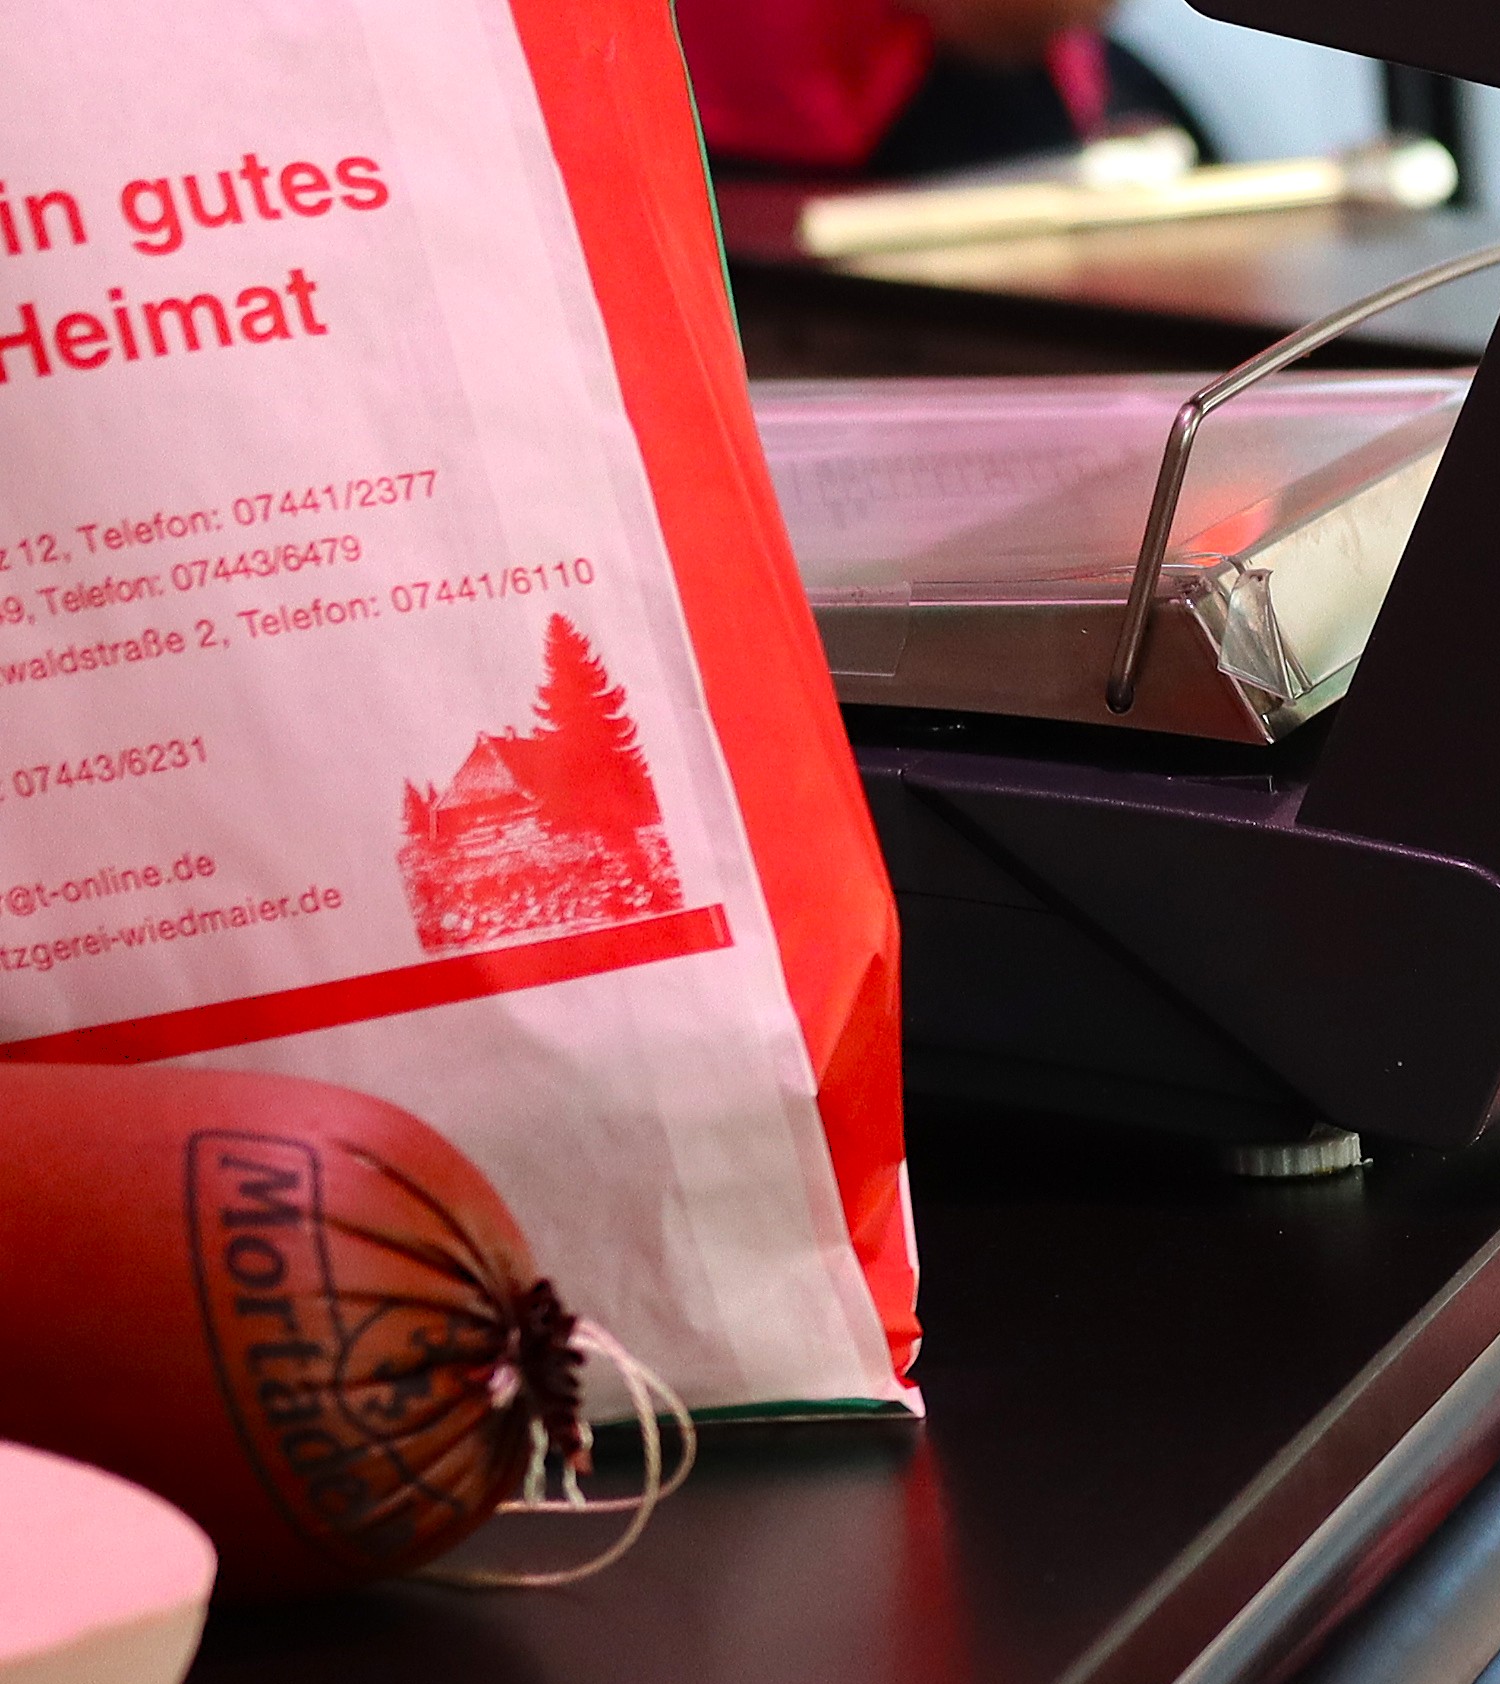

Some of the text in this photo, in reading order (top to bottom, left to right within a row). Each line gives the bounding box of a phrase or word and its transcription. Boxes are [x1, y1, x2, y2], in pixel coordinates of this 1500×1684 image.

[120, 153, 389, 255] gutes
[0, 268, 329, 384] Heimat
[18, 534, 72, 565] 12,
[76, 509, 224, 553] Telefon:
[232, 469, 437, 526] 07441/2377
[0, 535, 362, 625] 9, Telefon: 07443/6479
[195, 618, 231, 649] 2,
[236, 597, 381, 638] Telefon:
[390, 557, 595, 613] 07441/6110
[12, 735, 208, 798] 07443/6231
[0, 851, 217, 917] @t-online.de
